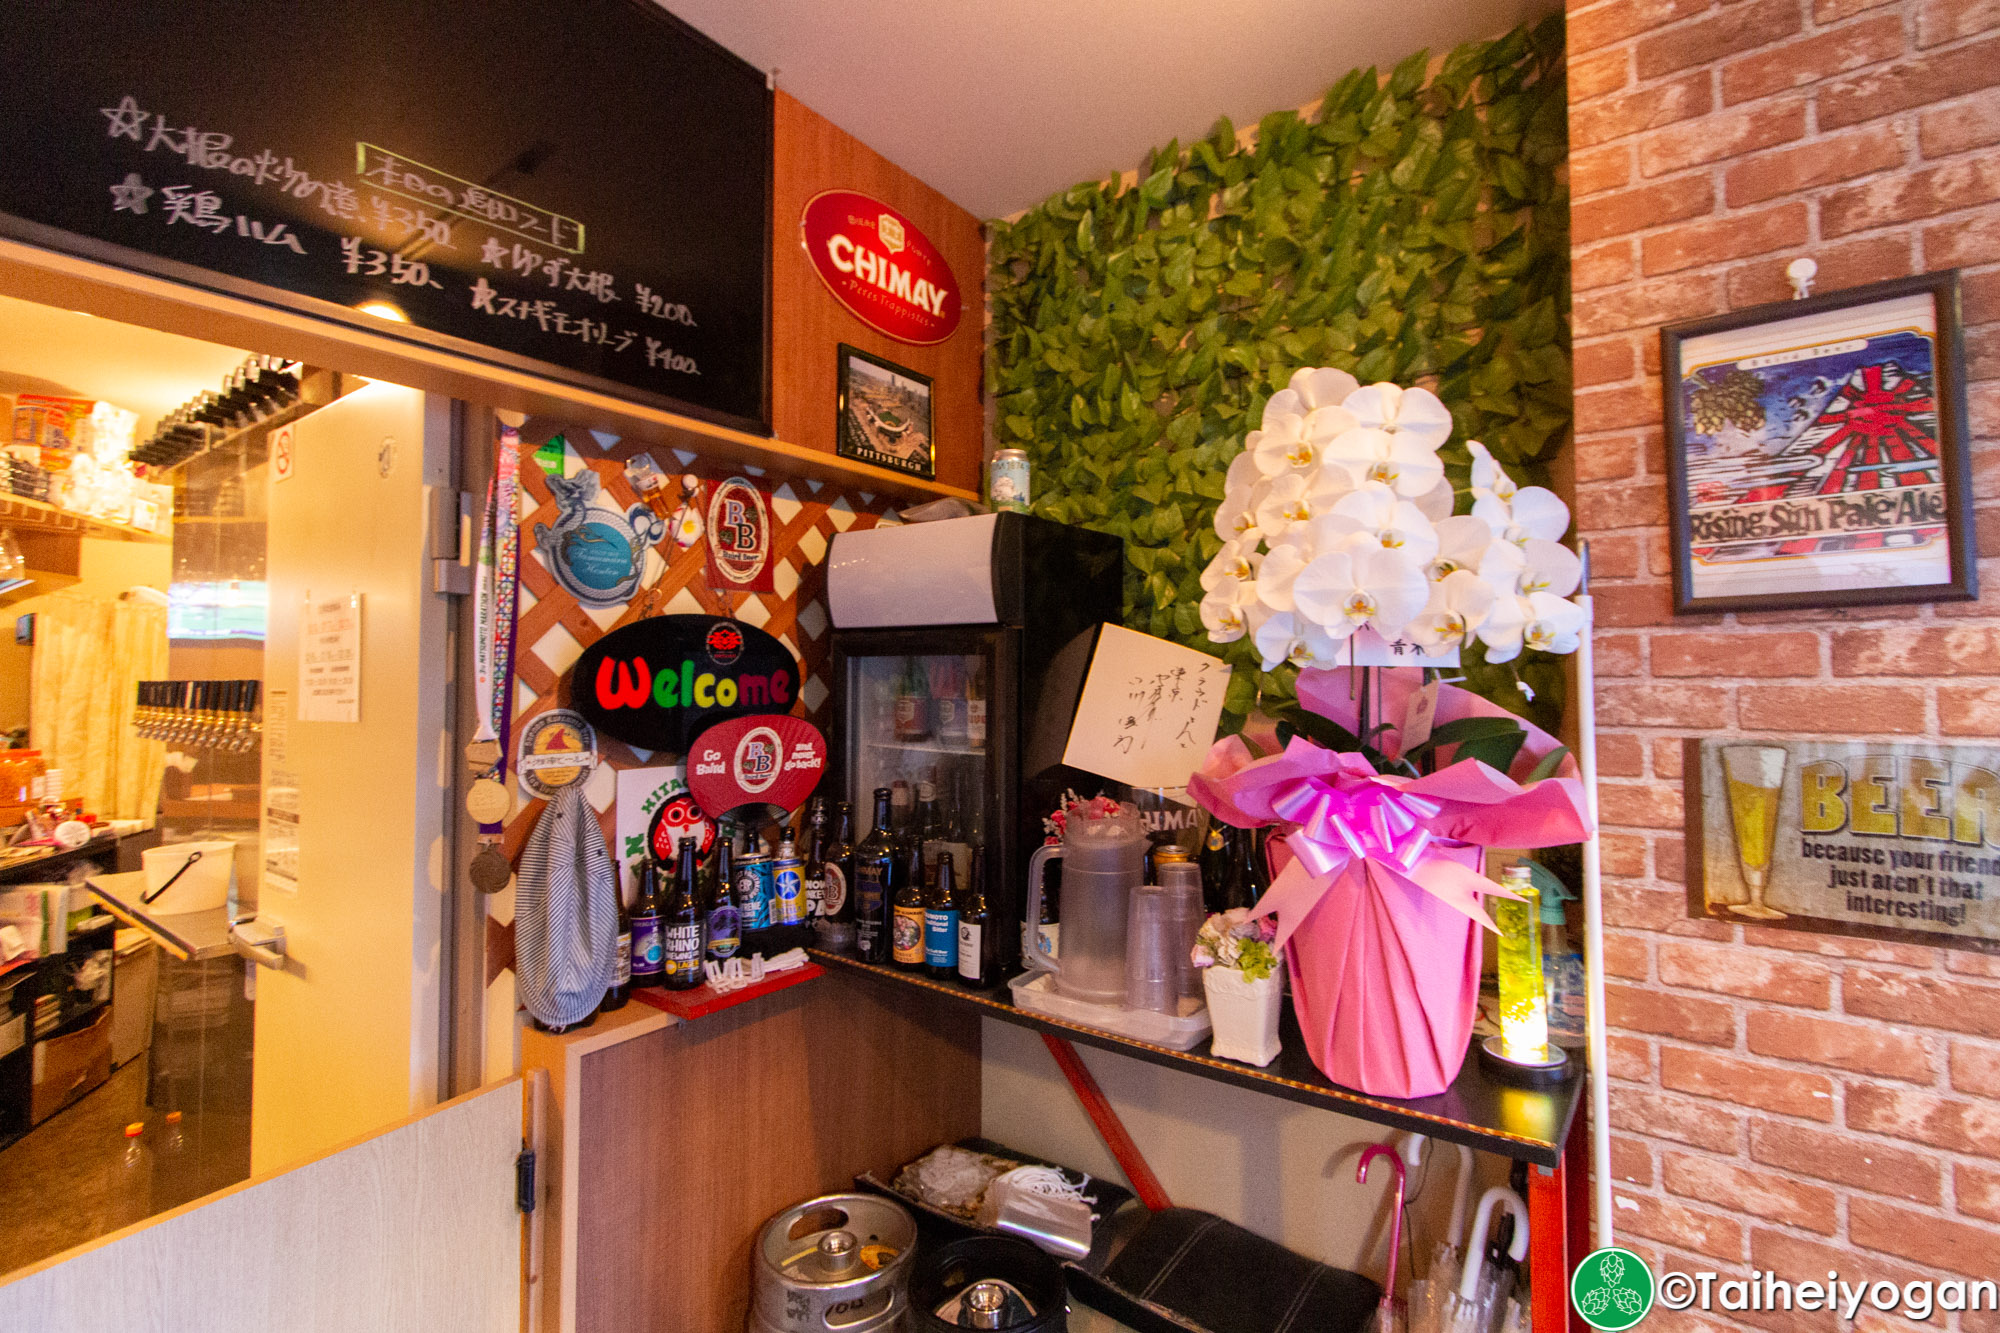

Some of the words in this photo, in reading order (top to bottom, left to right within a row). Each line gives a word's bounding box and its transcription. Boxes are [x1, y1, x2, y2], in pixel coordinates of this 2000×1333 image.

[827, 233, 948, 317] CHIMAY
[856, 446, 922, 472] PITTSBURGH
[1690, 509, 1766, 541] Rising
[1771, 503, 1823, 536] Sun
[1829, 496, 1896, 529] Pale
[1898, 488, 1946, 523] Ale
[595, 655, 790, 710] Welcome
[696, 761, 726, 775] Baird
[703, 749, 721, 761] Go
[1800, 755, 2000, 848] BEER
[1802, 838, 1885, 865] because
[1890, 849, 1934, 870] your
[1827, 865, 1869, 889] just
[1872, 873, 1934, 896] aren't
[1938, 877, 1984, 900] that
[1846, 891, 1966, 927] interesting!
[666, 925, 700, 940] WHITE
[666, 939, 700, 953] RHINO
